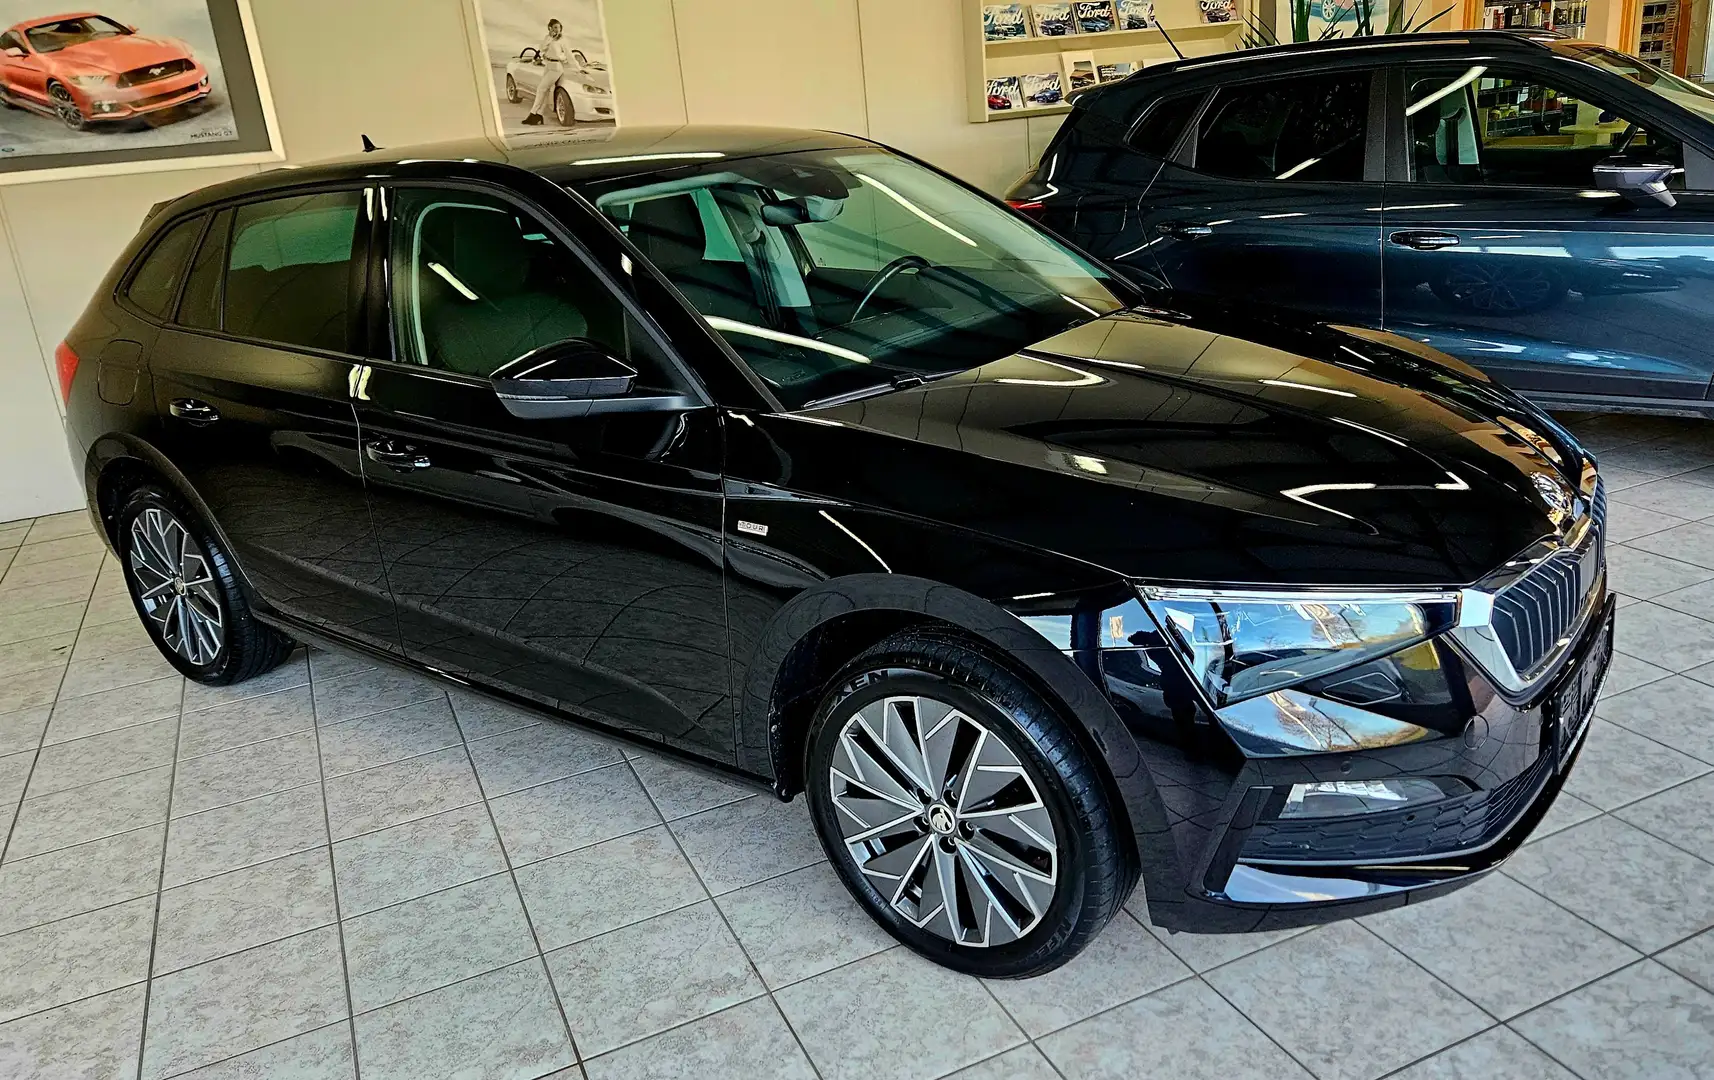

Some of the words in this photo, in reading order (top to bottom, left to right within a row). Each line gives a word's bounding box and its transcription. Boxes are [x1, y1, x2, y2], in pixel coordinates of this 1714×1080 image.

[984, 4, 1024, 25] Ford
[1078, 2, 1111, 18] Ford
[985, 80, 1020, 97] Ford
[1024, 76, 1060, 92] Ford
